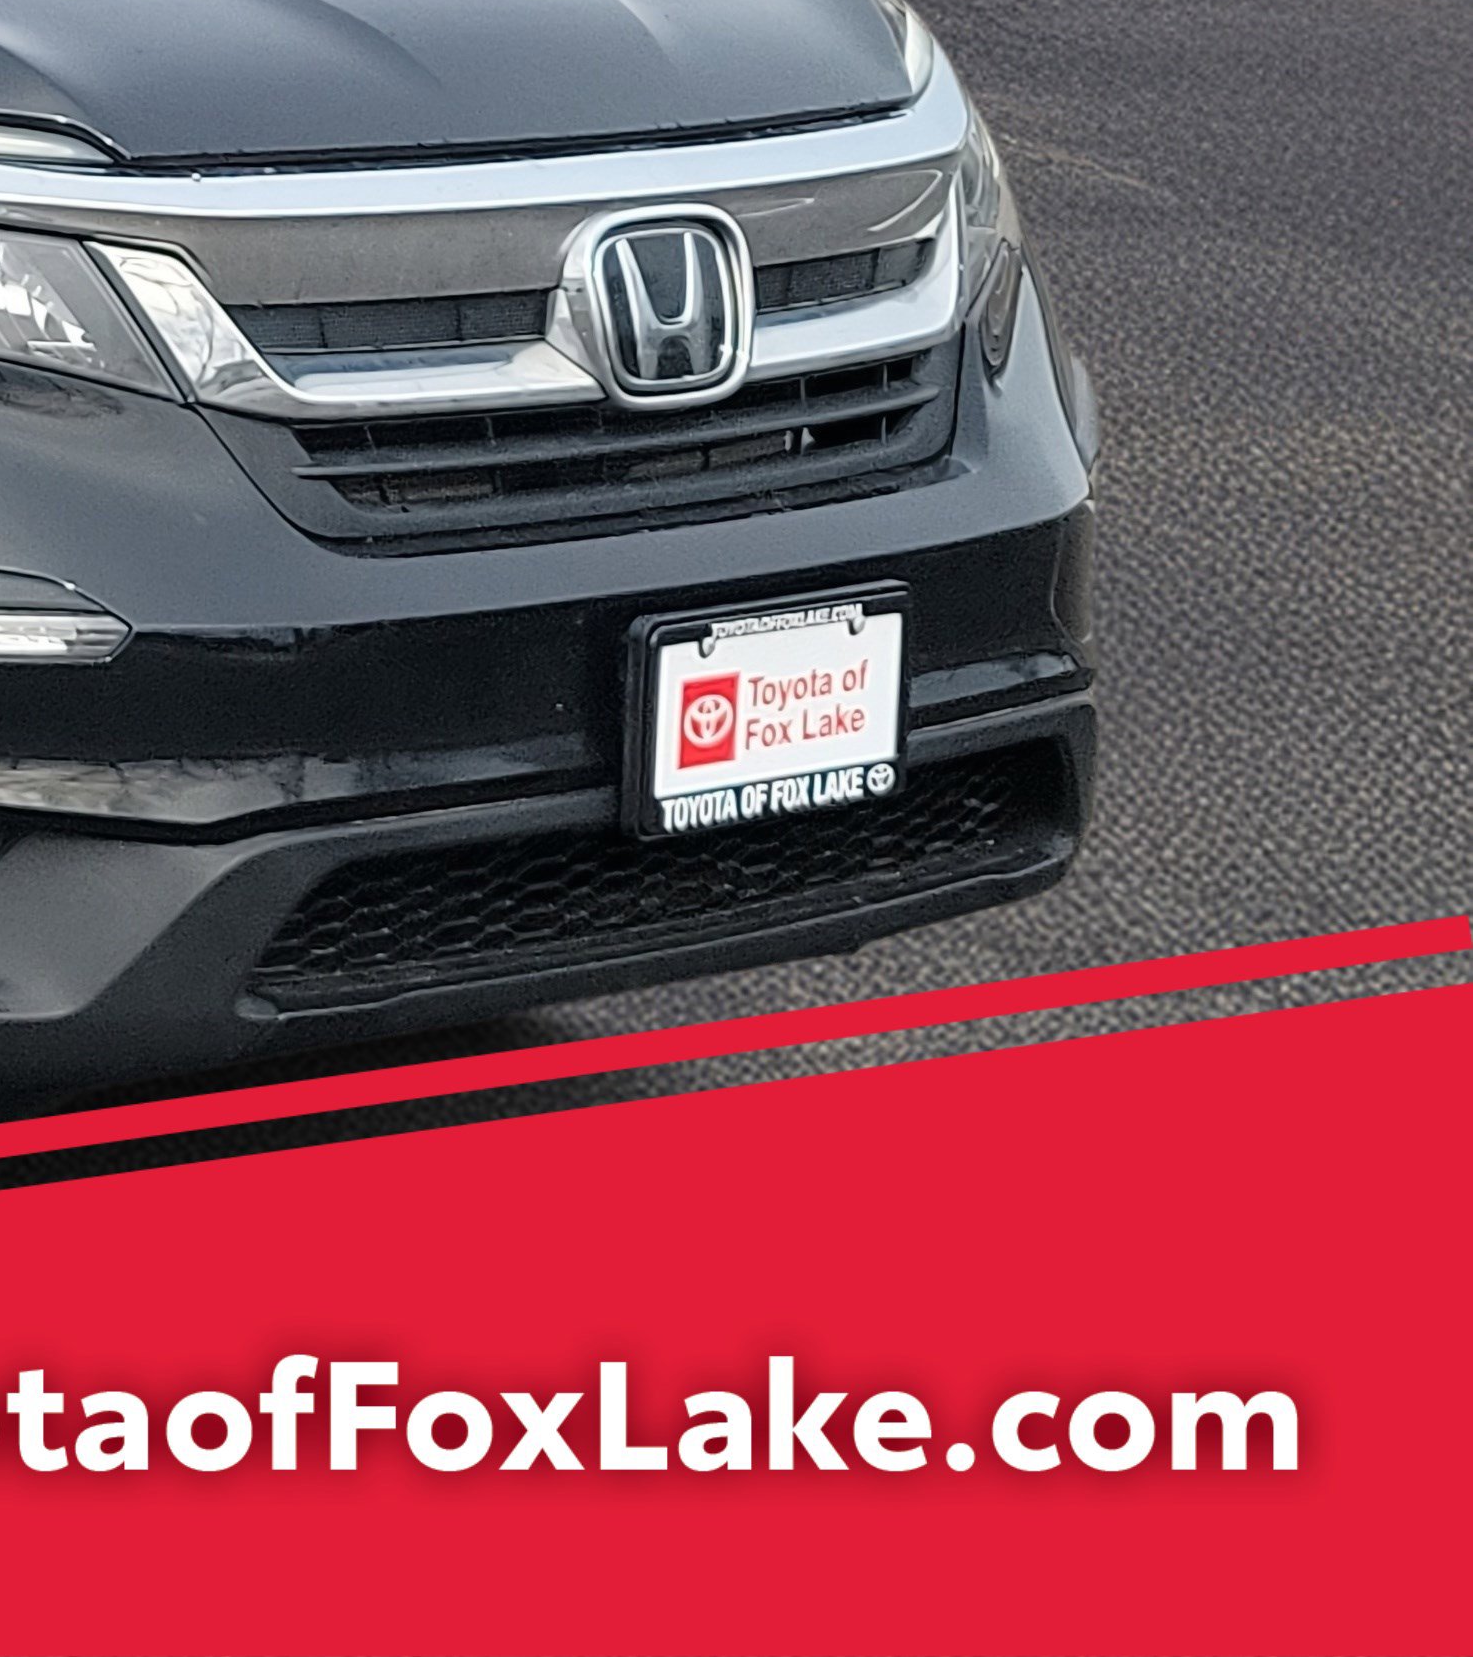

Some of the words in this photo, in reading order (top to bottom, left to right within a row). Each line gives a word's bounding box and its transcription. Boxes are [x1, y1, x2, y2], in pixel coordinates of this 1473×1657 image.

[748, 669, 832, 711] Toyota
[842, 659, 868, 691] of
[745, 718, 793, 750] Fox
[803, 703, 865, 740] Lake
[662, 789, 738, 833] TOYOTA
[741, 783, 768, 819] OF
[770, 775, 810, 814] FOX
[813, 767, 864, 806] LAKE
